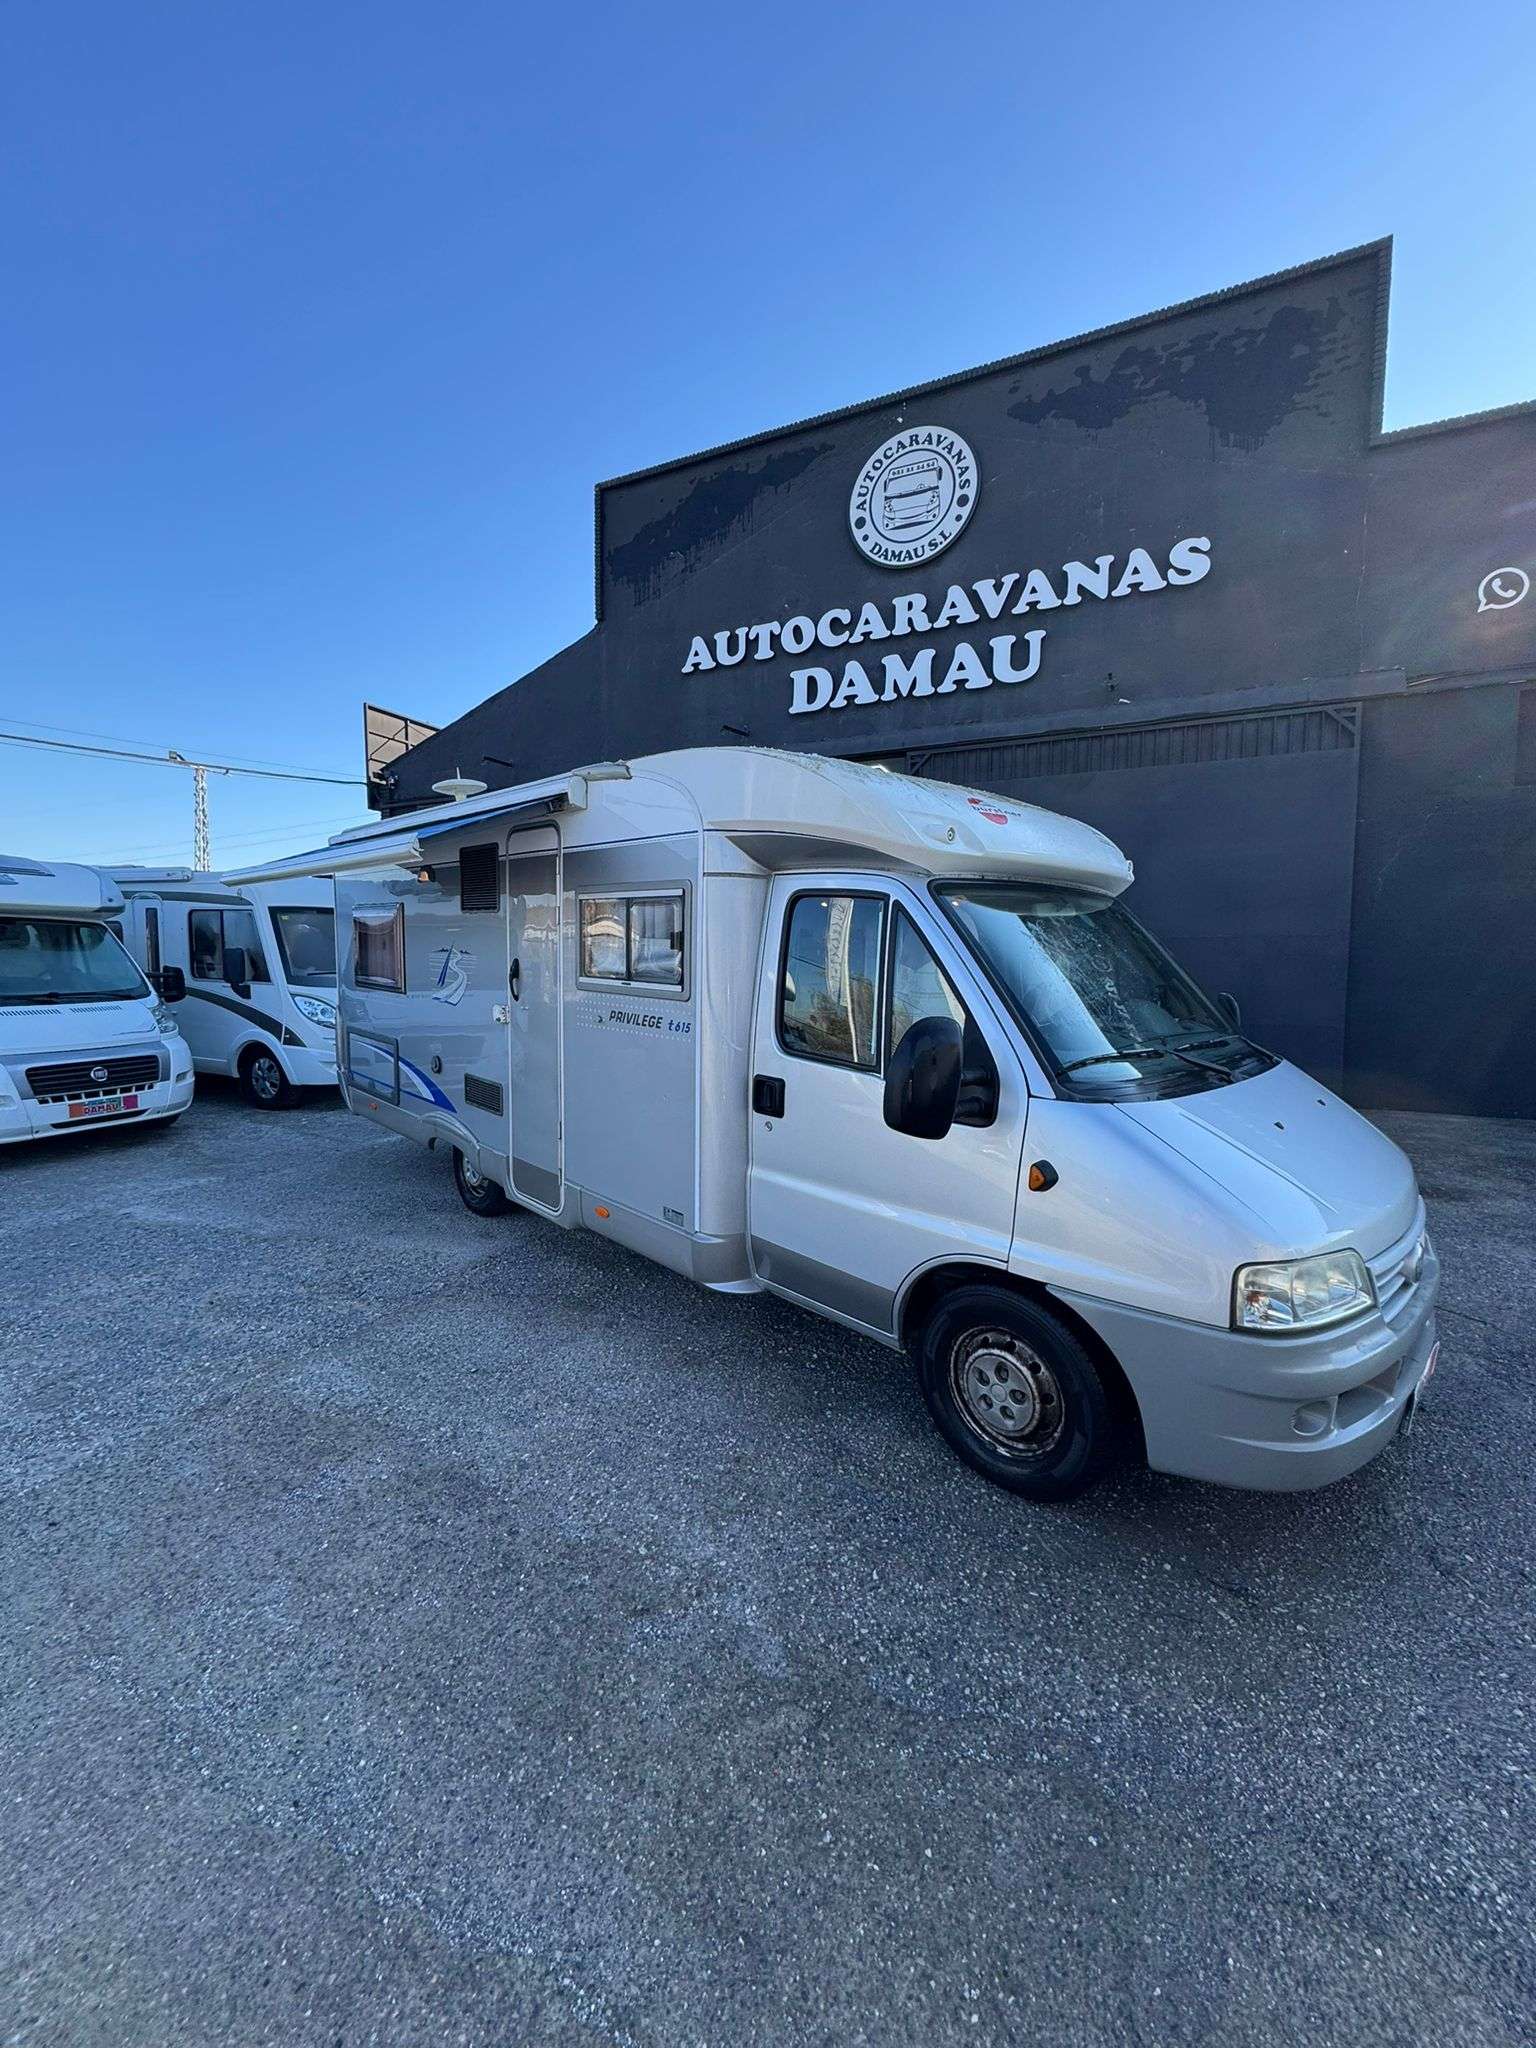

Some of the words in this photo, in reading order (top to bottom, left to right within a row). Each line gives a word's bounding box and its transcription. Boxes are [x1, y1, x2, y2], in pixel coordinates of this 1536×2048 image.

[855, 432, 971, 512] AUTOCARAVANAS
[869, 542, 925, 562] DAMAU
[681, 536, 1213, 674] AUTOCARAVANAS
[788, 629, 1047, 715] DAMAU
[609, 1010, 663, 1029] PRIVILEGE
